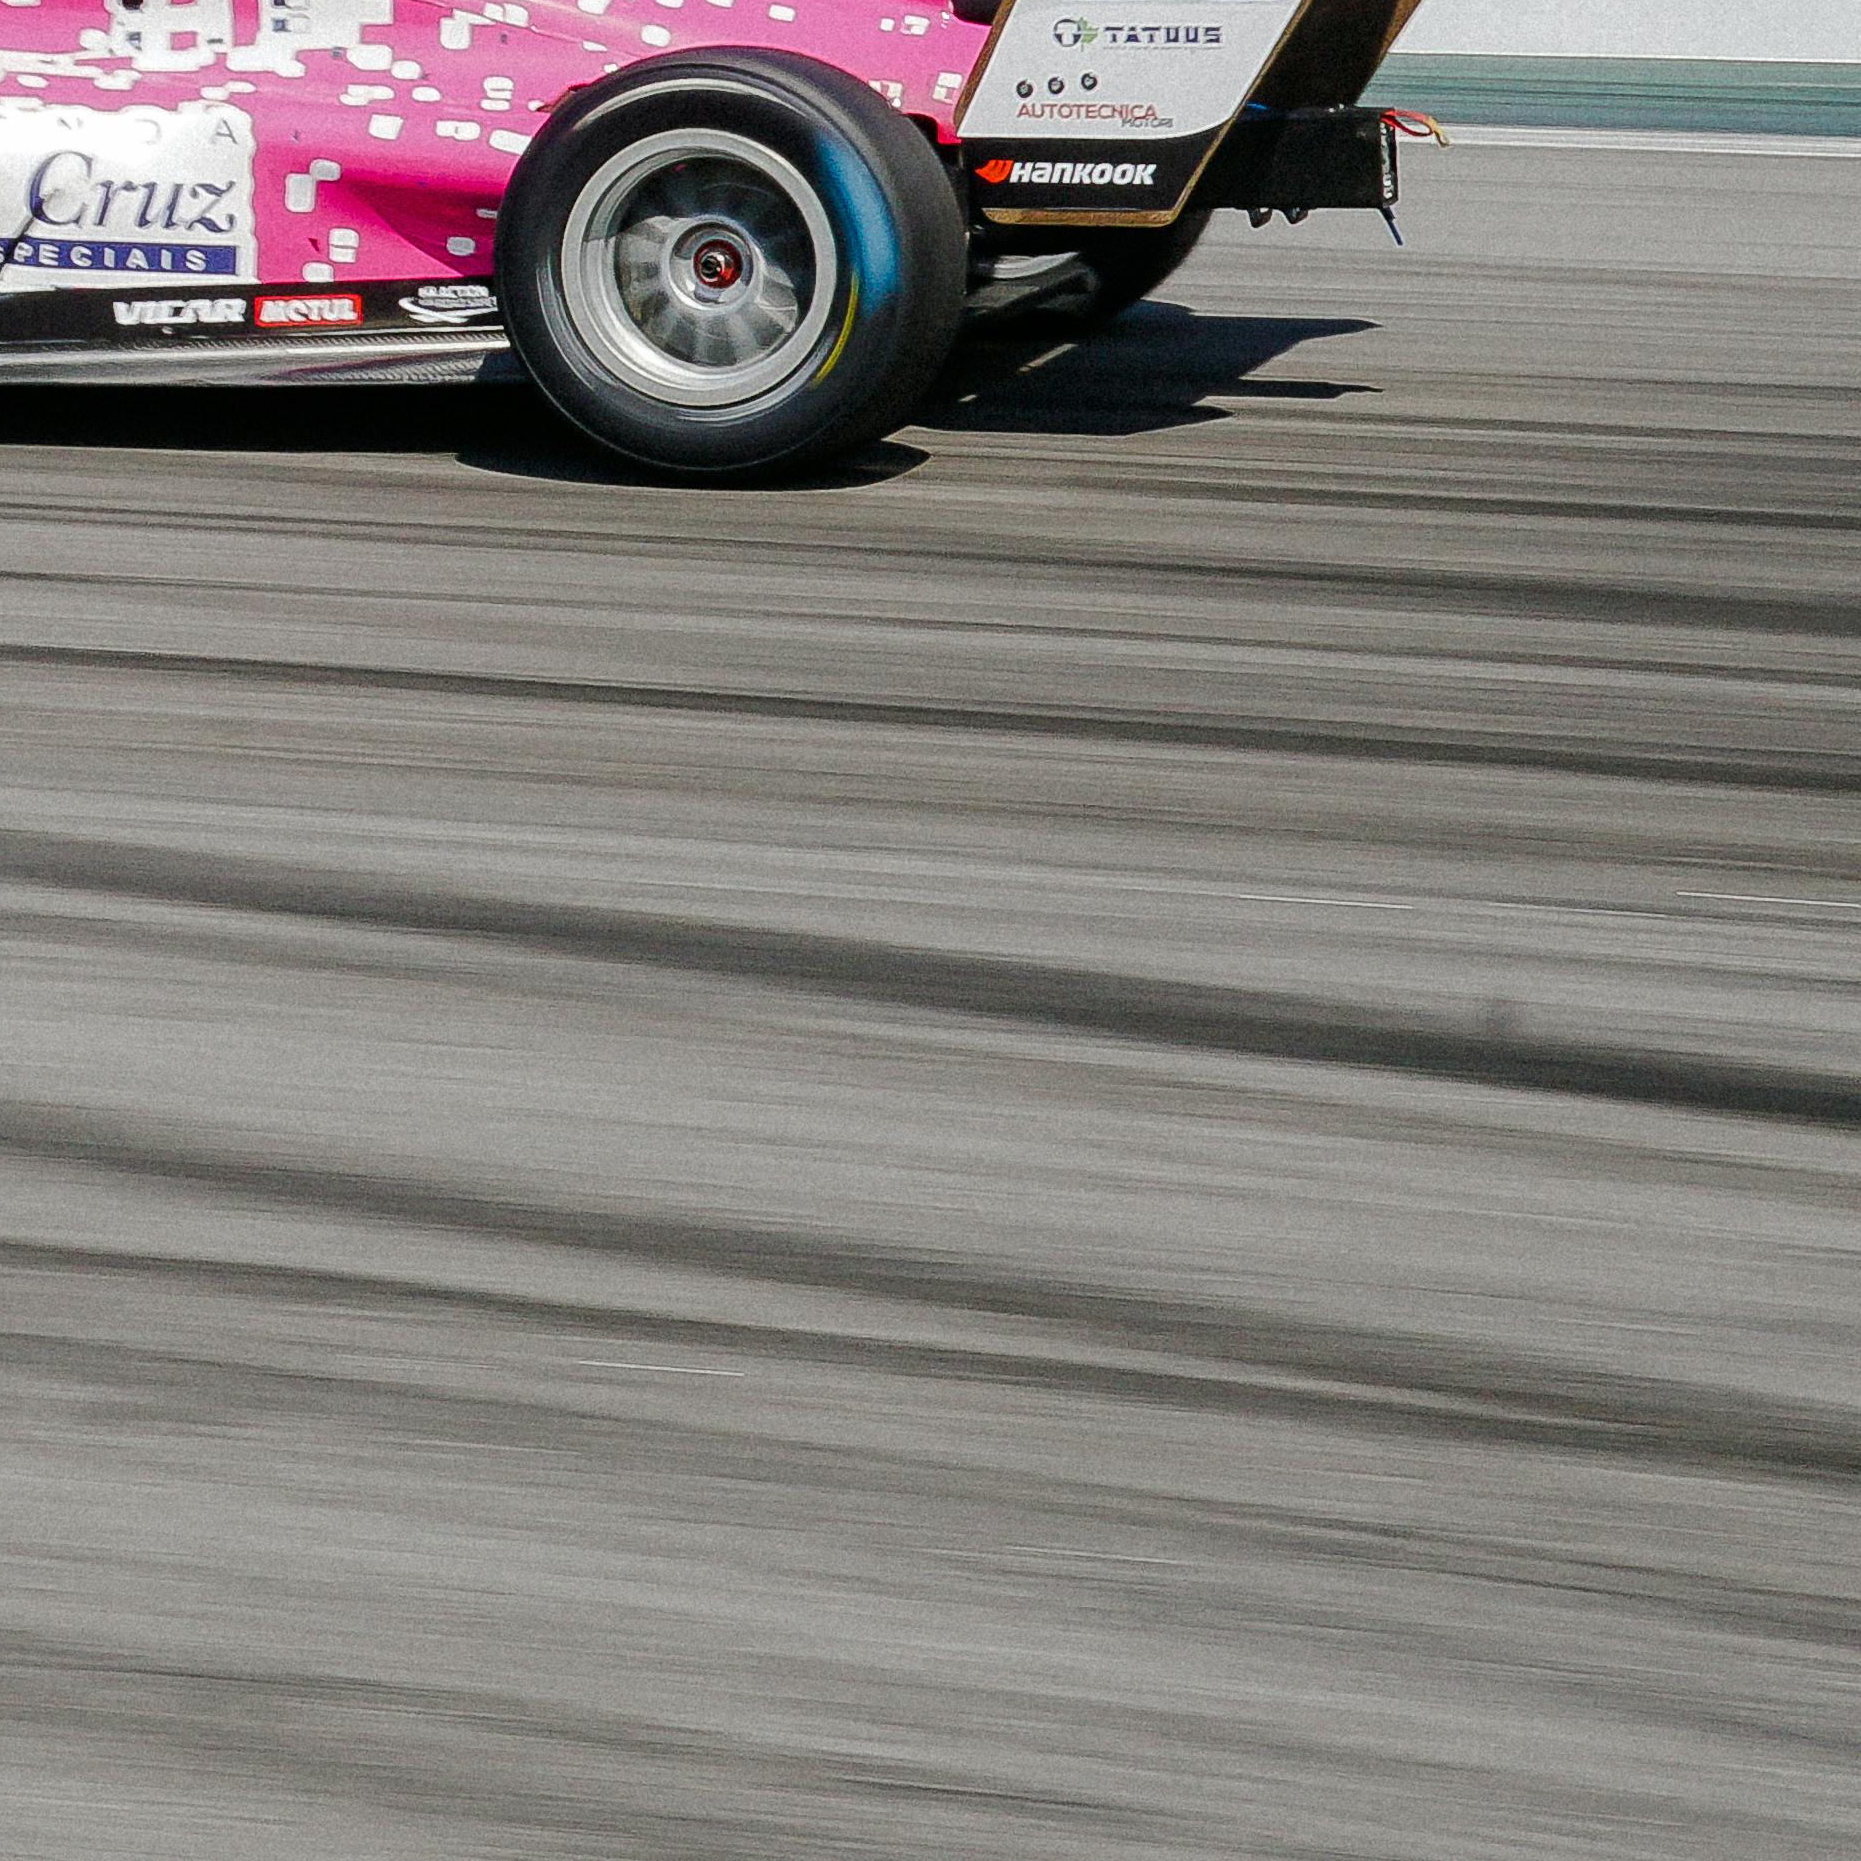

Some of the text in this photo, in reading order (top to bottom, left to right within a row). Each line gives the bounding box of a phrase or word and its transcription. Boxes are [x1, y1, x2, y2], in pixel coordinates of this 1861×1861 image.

[1104, 26, 1222, 44] TATUUS
[1016, 103, 1157, 120] AUTOTECNICA
[29, 151, 236, 233] Cruz
[113, 299, 246, 325] VICAR
[259, 298, 357, 322] MOTUL
